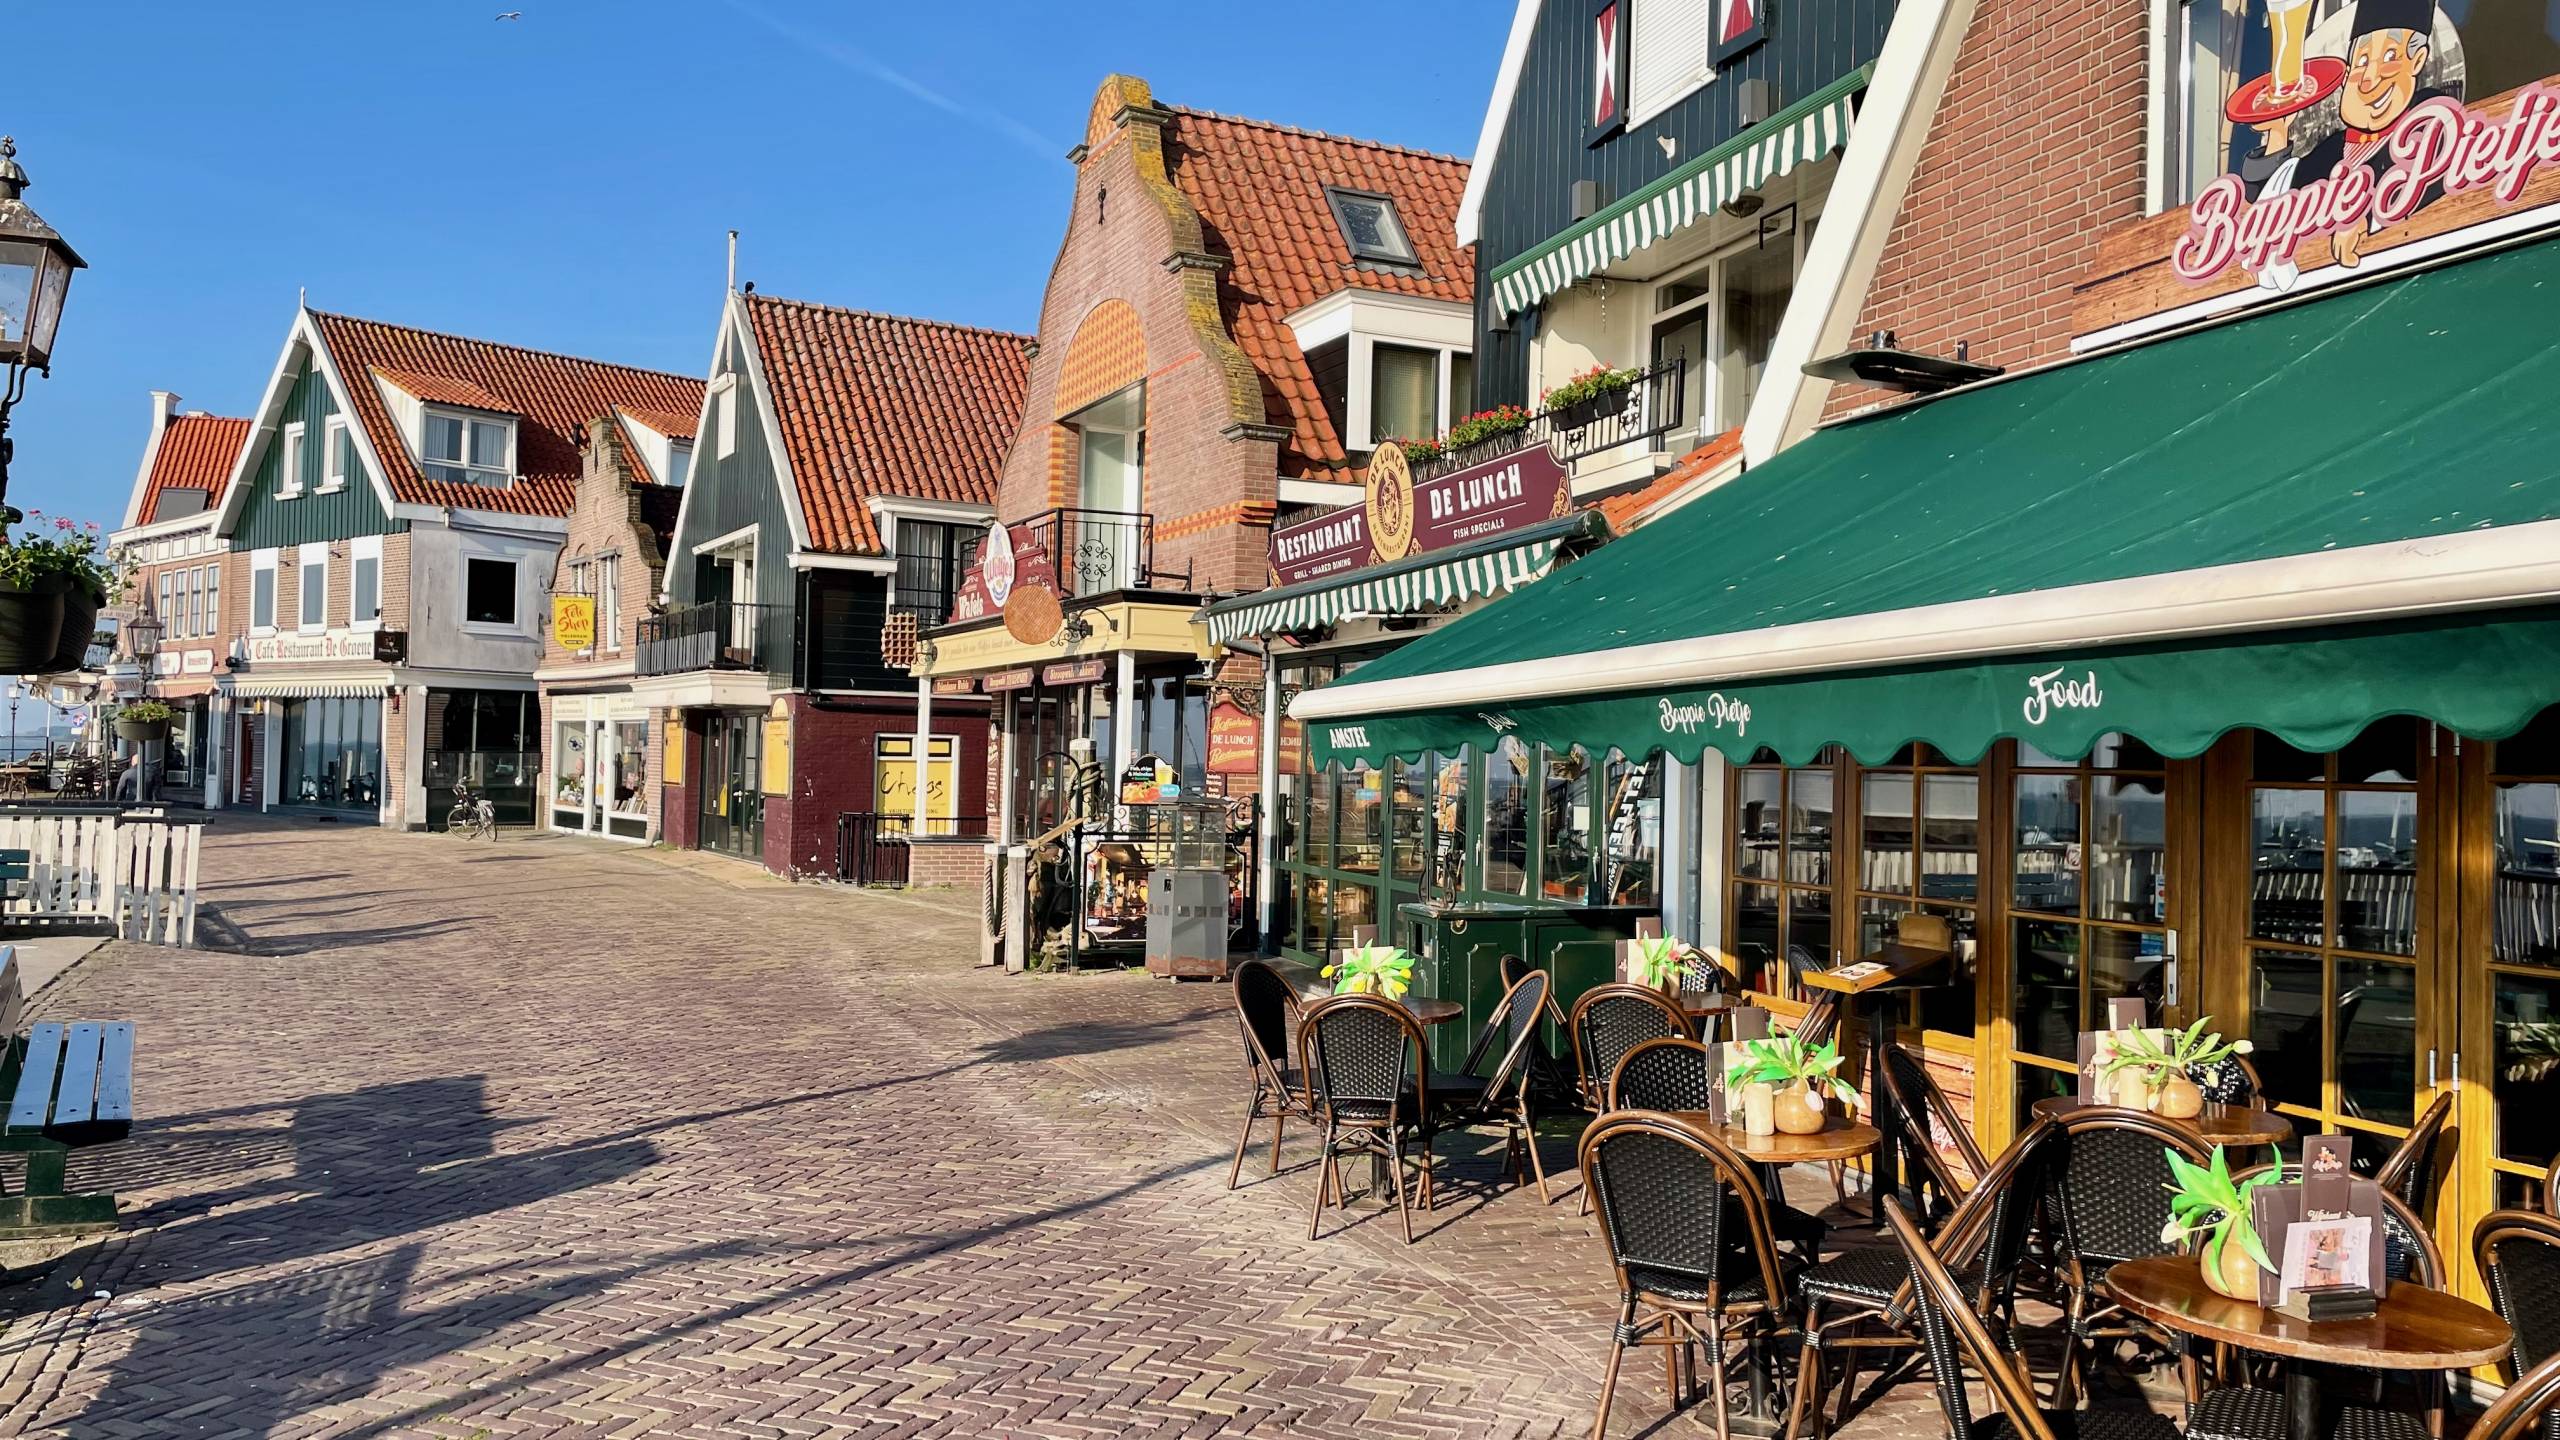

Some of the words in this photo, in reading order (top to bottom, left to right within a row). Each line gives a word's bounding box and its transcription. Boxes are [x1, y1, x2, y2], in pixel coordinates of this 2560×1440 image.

[2173, 164, 2373, 280] Bappie
[2374, 88, 2560, 223] Pietje
[1380, 449, 1405, 476] LUNCH
[1429, 487, 1454, 520] DE
[1458, 462, 1522, 512] LUNCH
[1277, 513, 1362, 563] RESTAURANT
[1453, 527, 1470, 540] FISH
[1471, 517, 1505, 535] SPECIALS
[1293, 568, 1309, 580] GRILL
[1311, 564, 1332, 575] SHARED
[1332, 557, 1352, 570] DINING
[2023, 665, 2103, 725] Food
[1658, 697, 1706, 734] Bappie
[1707, 692, 1752, 737] Pietje
[1212, 735, 1224, 744] DE
[1224, 735, 1253, 745] LUNCH
[1329, 726, 1370, 749] AMSTEL
